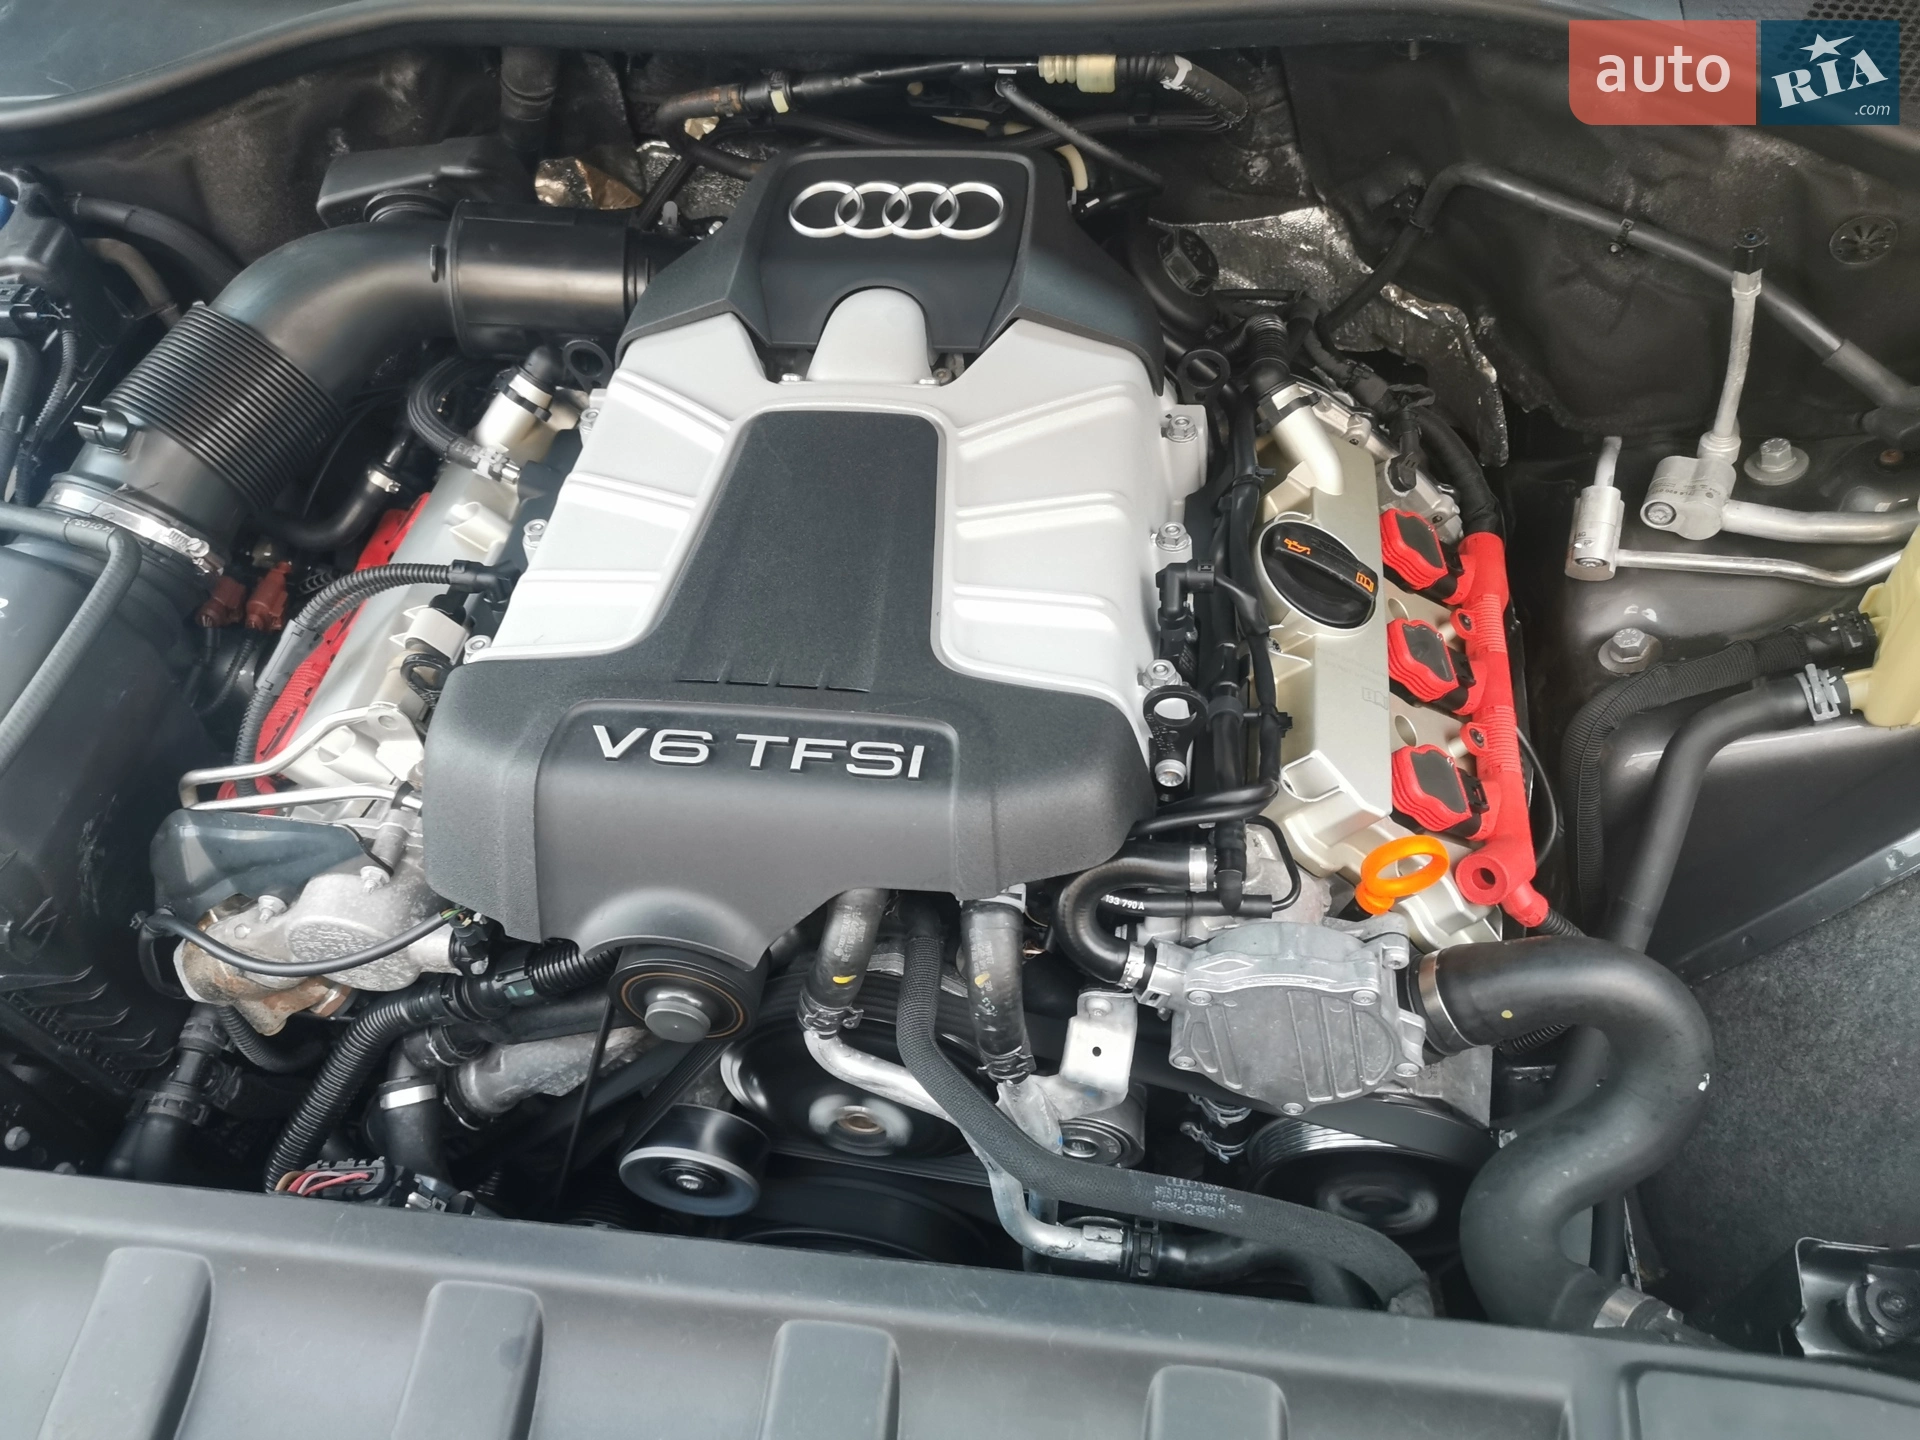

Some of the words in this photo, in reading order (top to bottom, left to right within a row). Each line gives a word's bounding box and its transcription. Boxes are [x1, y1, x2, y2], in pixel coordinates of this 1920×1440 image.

[592, 724, 714, 766] V6
[736, 733, 925, 780] TFSI
[1106, 894, 1120, 905] 133
[1122, 899, 1137, 909] 790
[1138, 902, 1144, 910] A
